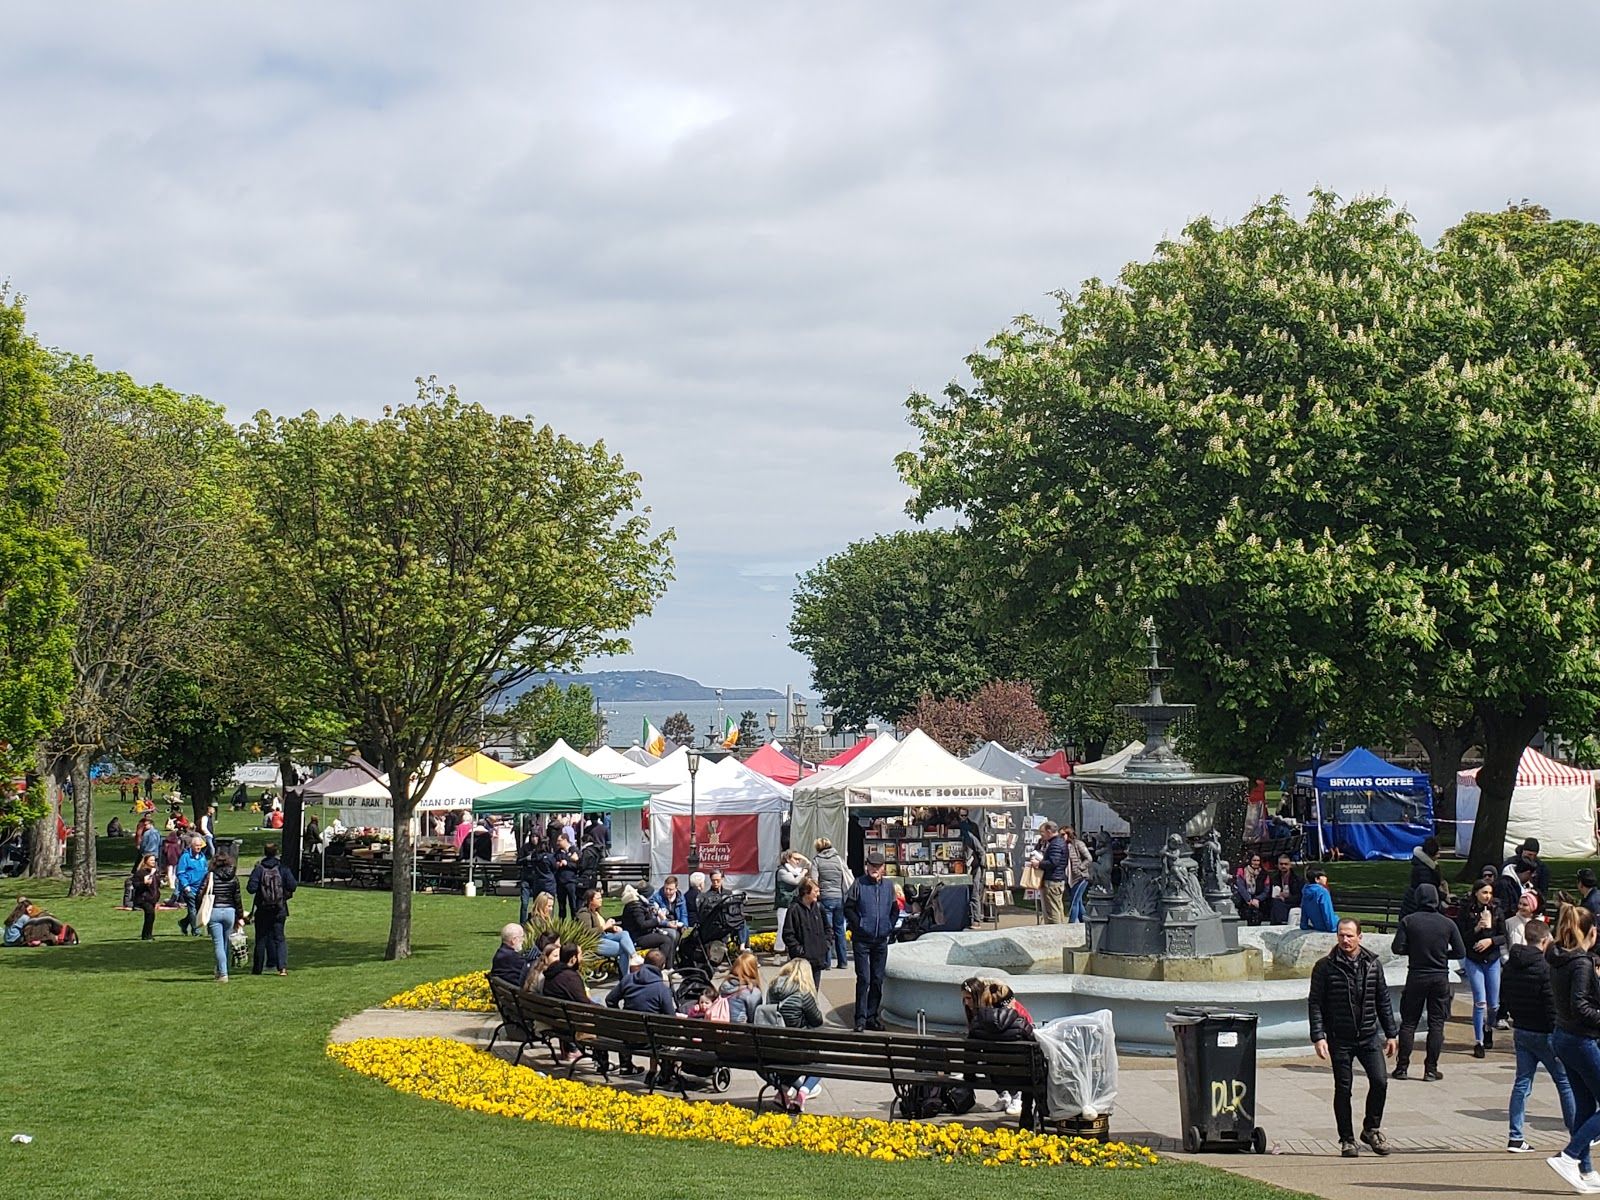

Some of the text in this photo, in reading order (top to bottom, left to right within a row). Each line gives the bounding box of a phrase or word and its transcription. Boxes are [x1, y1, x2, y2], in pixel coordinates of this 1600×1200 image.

[1330, 777, 1414, 787] BRYAN'S COFFEE
[889, 786, 995, 797] VILLAGE BOOKSHOP
[328, 797, 343, 806] MAN
[347, 797, 357, 806] OF
[361, 797, 380, 807] ARAN
[420, 798, 441, 807] MAN
[444, 798, 456, 806] OF
[699, 852, 731, 862] Kitchen
[1211, 1079, 1252, 1120] DLR
